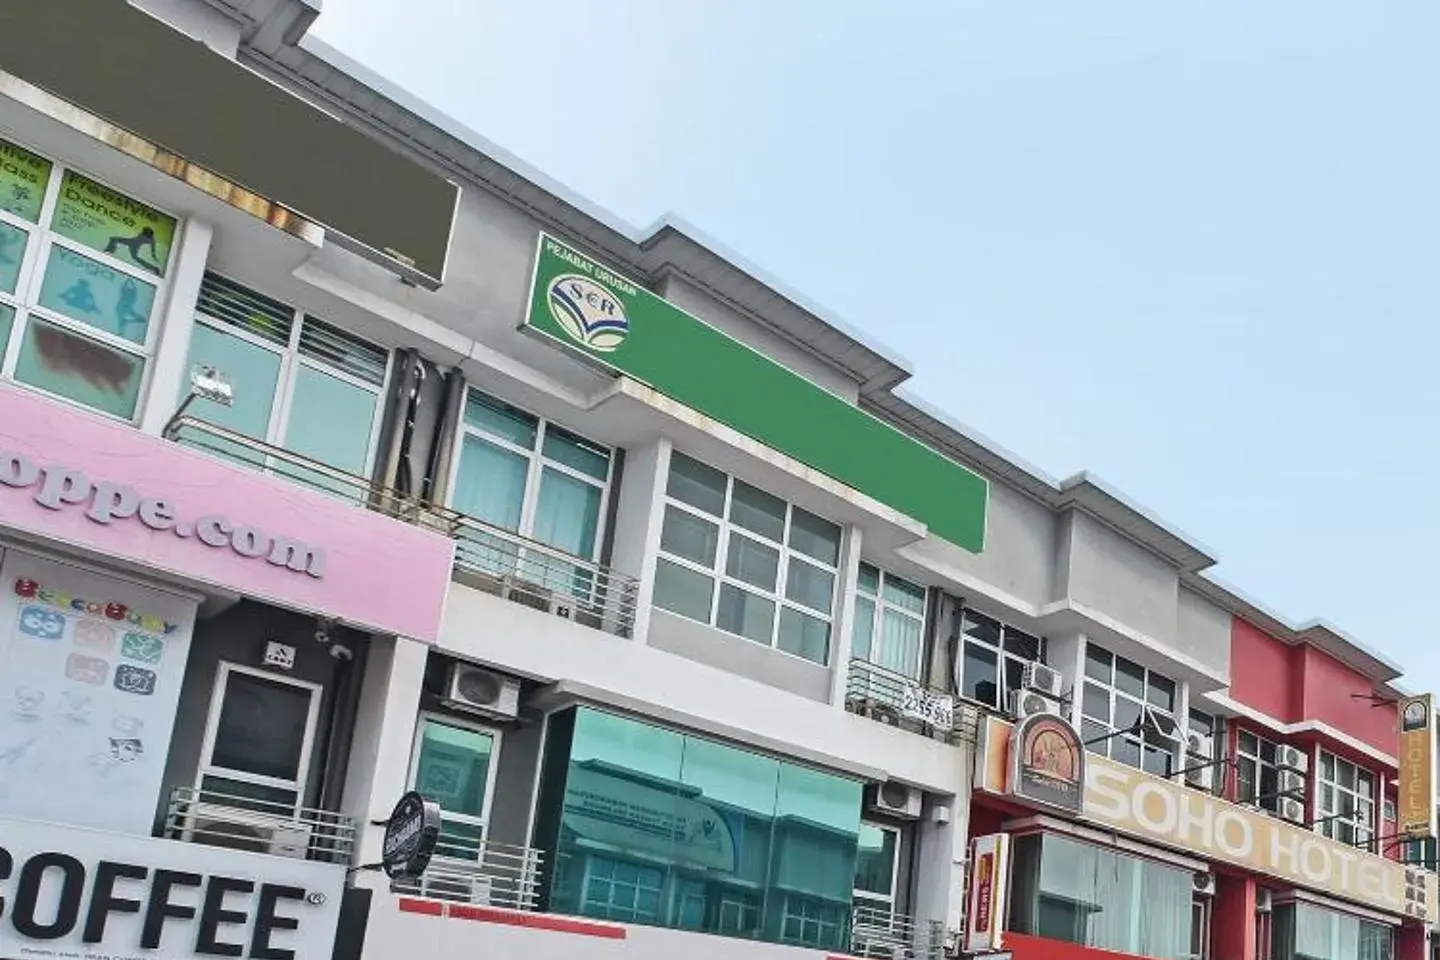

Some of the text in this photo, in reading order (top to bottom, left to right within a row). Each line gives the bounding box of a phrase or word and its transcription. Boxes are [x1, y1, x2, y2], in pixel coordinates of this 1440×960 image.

[65, 187, 137, 228] Dance
[546, 240, 593, 273] PEJABAT
[1085, 764, 1402, 905] SOHO HOTEL
